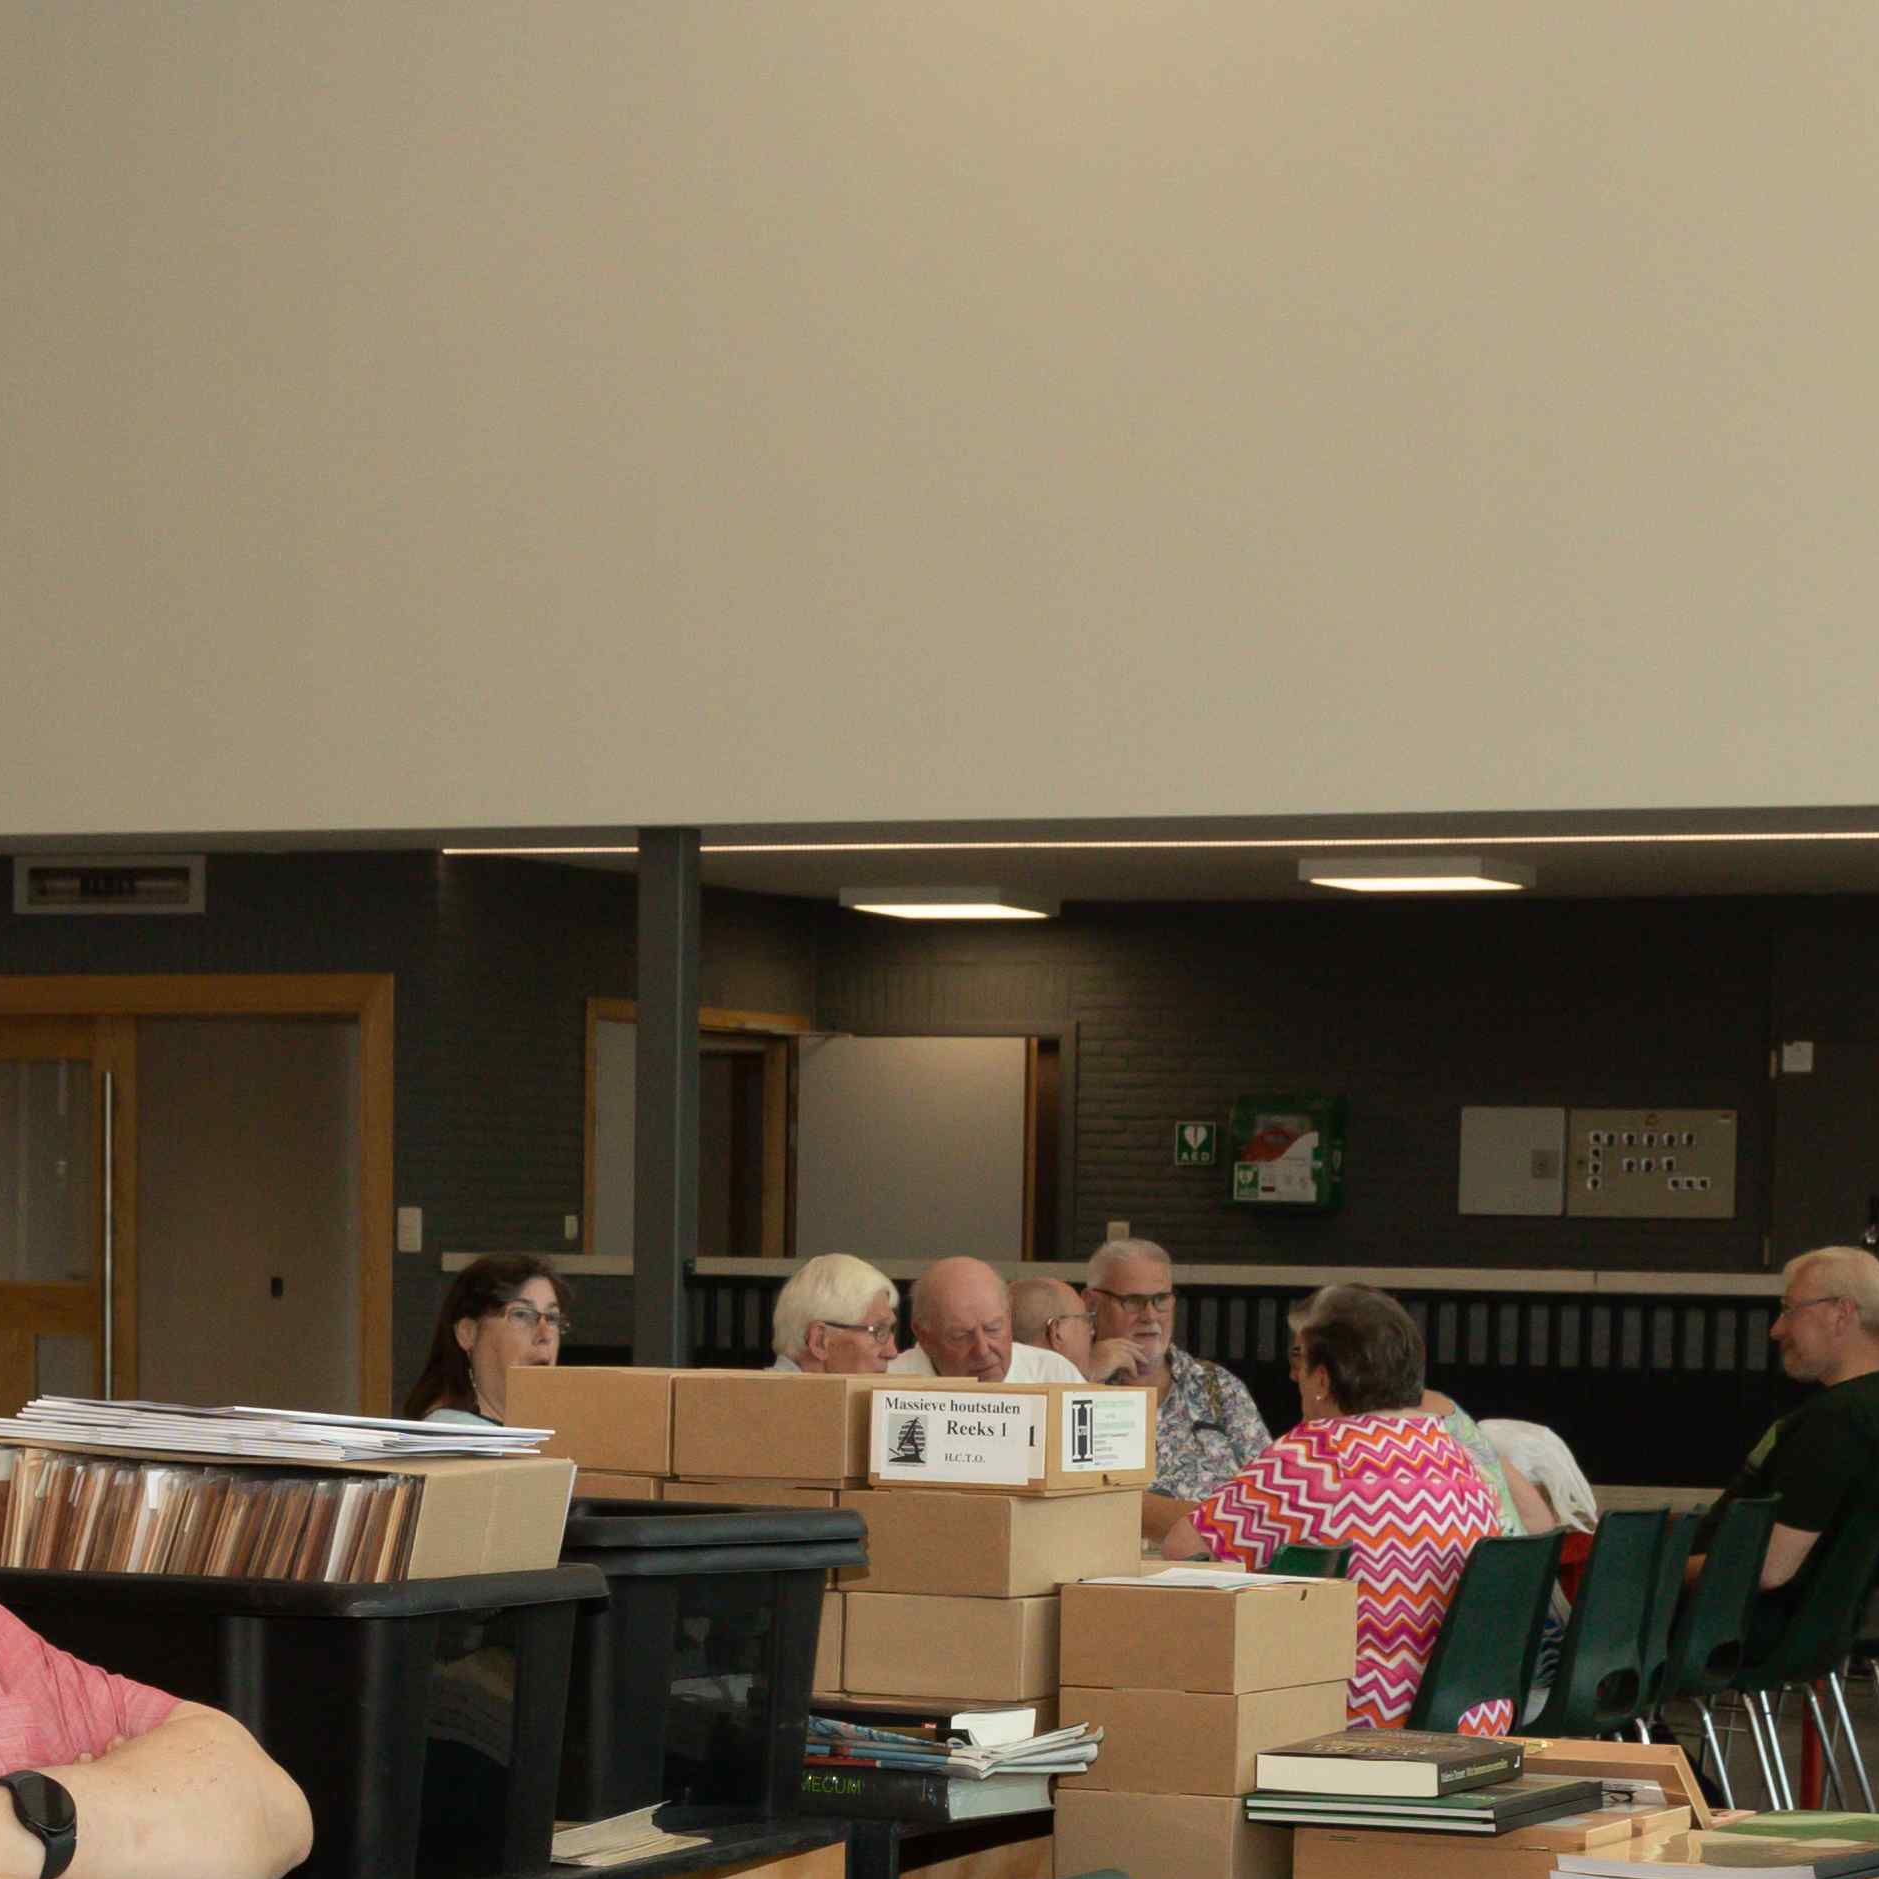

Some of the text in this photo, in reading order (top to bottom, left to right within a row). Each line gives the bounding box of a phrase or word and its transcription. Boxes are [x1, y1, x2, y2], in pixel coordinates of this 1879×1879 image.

[1180, 1151, 1210, 1161] AED
[884, 1397, 1021, 1415] Massieve houtstalen
[945, 1420, 1008, 1437] Reeks 1
[1028, 1425, 1035, 1447] 1
[943, 1452, 987, 1465] H.C.T.O.
